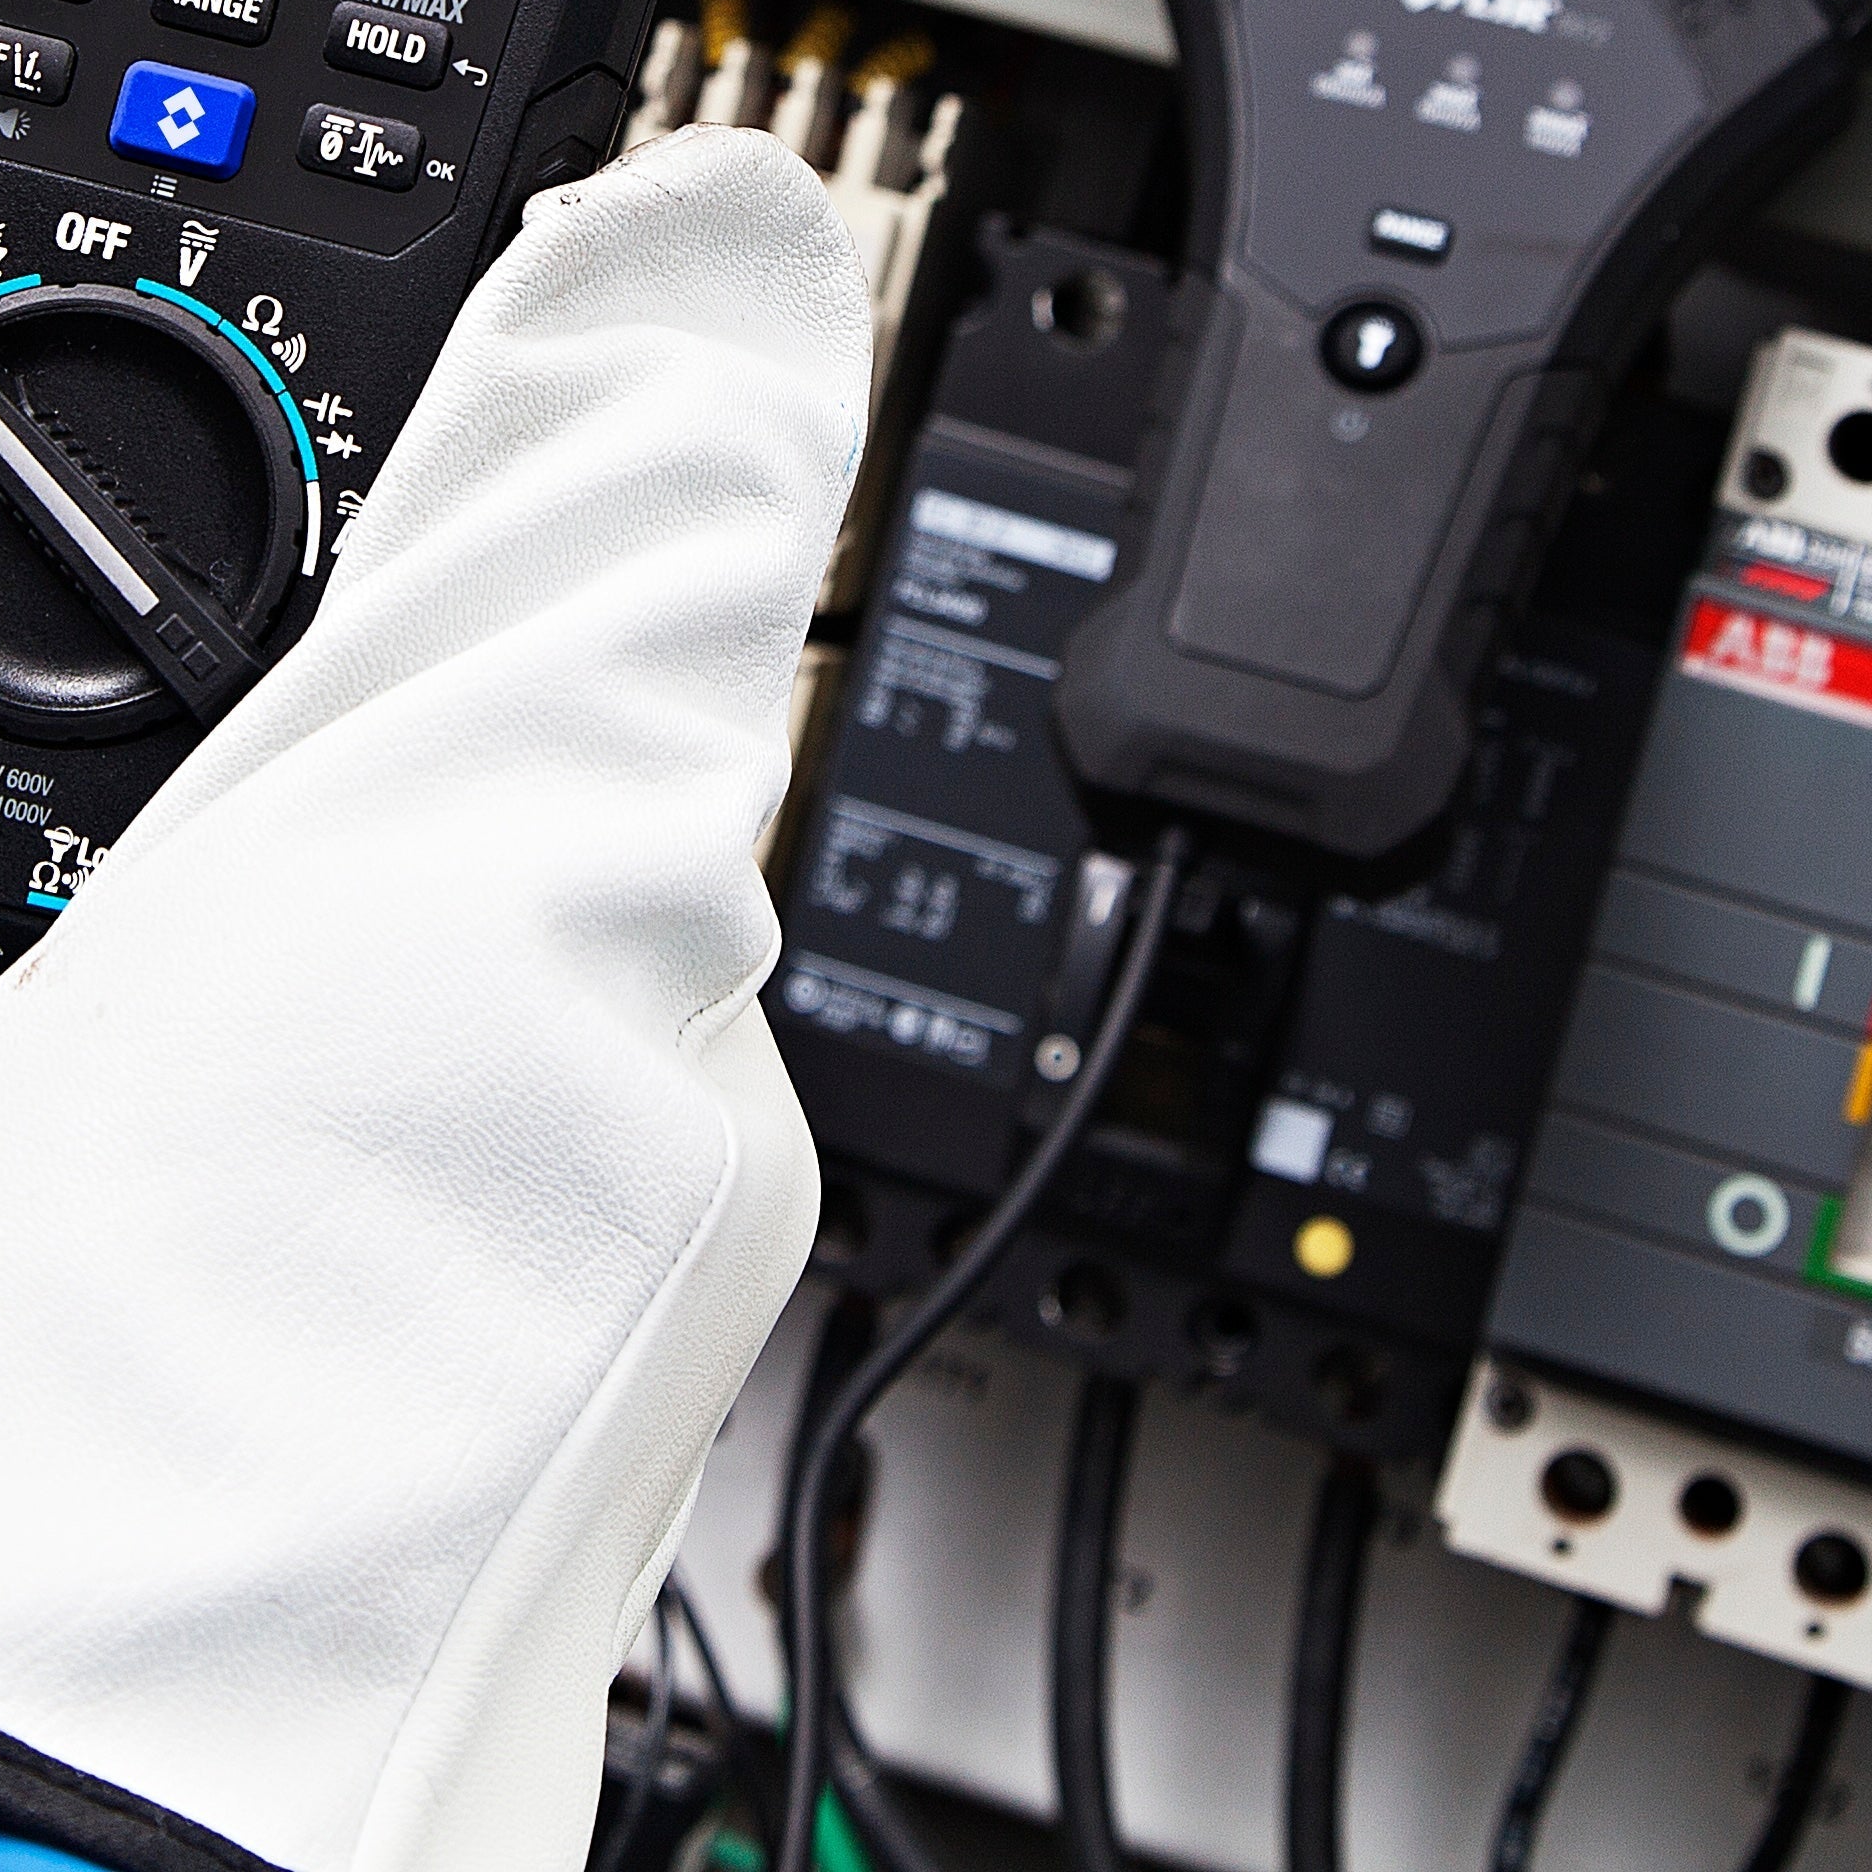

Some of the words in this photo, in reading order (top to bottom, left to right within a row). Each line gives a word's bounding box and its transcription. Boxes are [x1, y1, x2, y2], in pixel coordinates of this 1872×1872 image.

[346, 19, 427, 64] HOLD
[426, 160, 456, 181] OK
[56, 211, 132, 261] OFF
[179, 246, 207, 287] V
[1708, 612, 1836, 688] ABB
[6, 768, 54, 797] 600V
[76, 837, 111, 868] Lo
